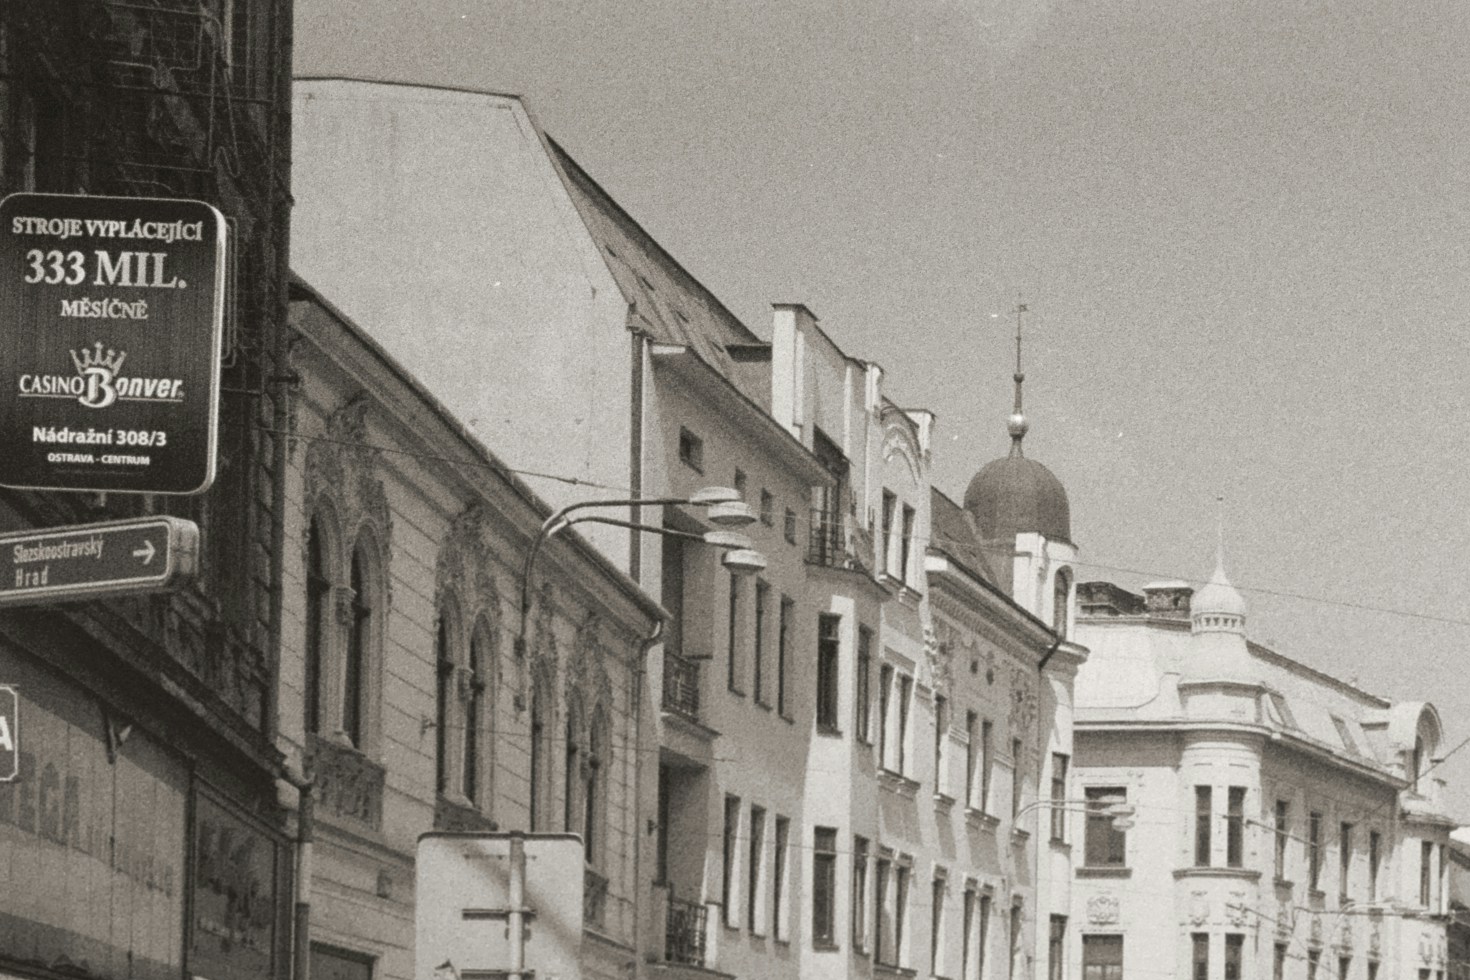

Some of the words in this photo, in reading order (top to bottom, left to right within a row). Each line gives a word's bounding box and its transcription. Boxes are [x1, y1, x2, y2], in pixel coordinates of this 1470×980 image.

[12, 217, 82, 240] STROJE
[84, 218, 203, 243] VYPLÁCEJÍCÍ
[24, 250, 86, 285] 333
[93, 250, 187, 289] MIL.
[60, 297, 148, 320] MĚSÍČNĚ
[19, 375, 85, 394] CASINO
[78, 367, 184, 408] Bonver
[32, 427, 113, 445] Nádražní
[116, 430, 167, 447] 308/3
[47, 453, 95, 464] OSTRAVA
[101, 454, 150, 465] CENTRUM
[13, 534, 103, 563] Slezskoostravský
[15, 565, 49, 587] Hrad
